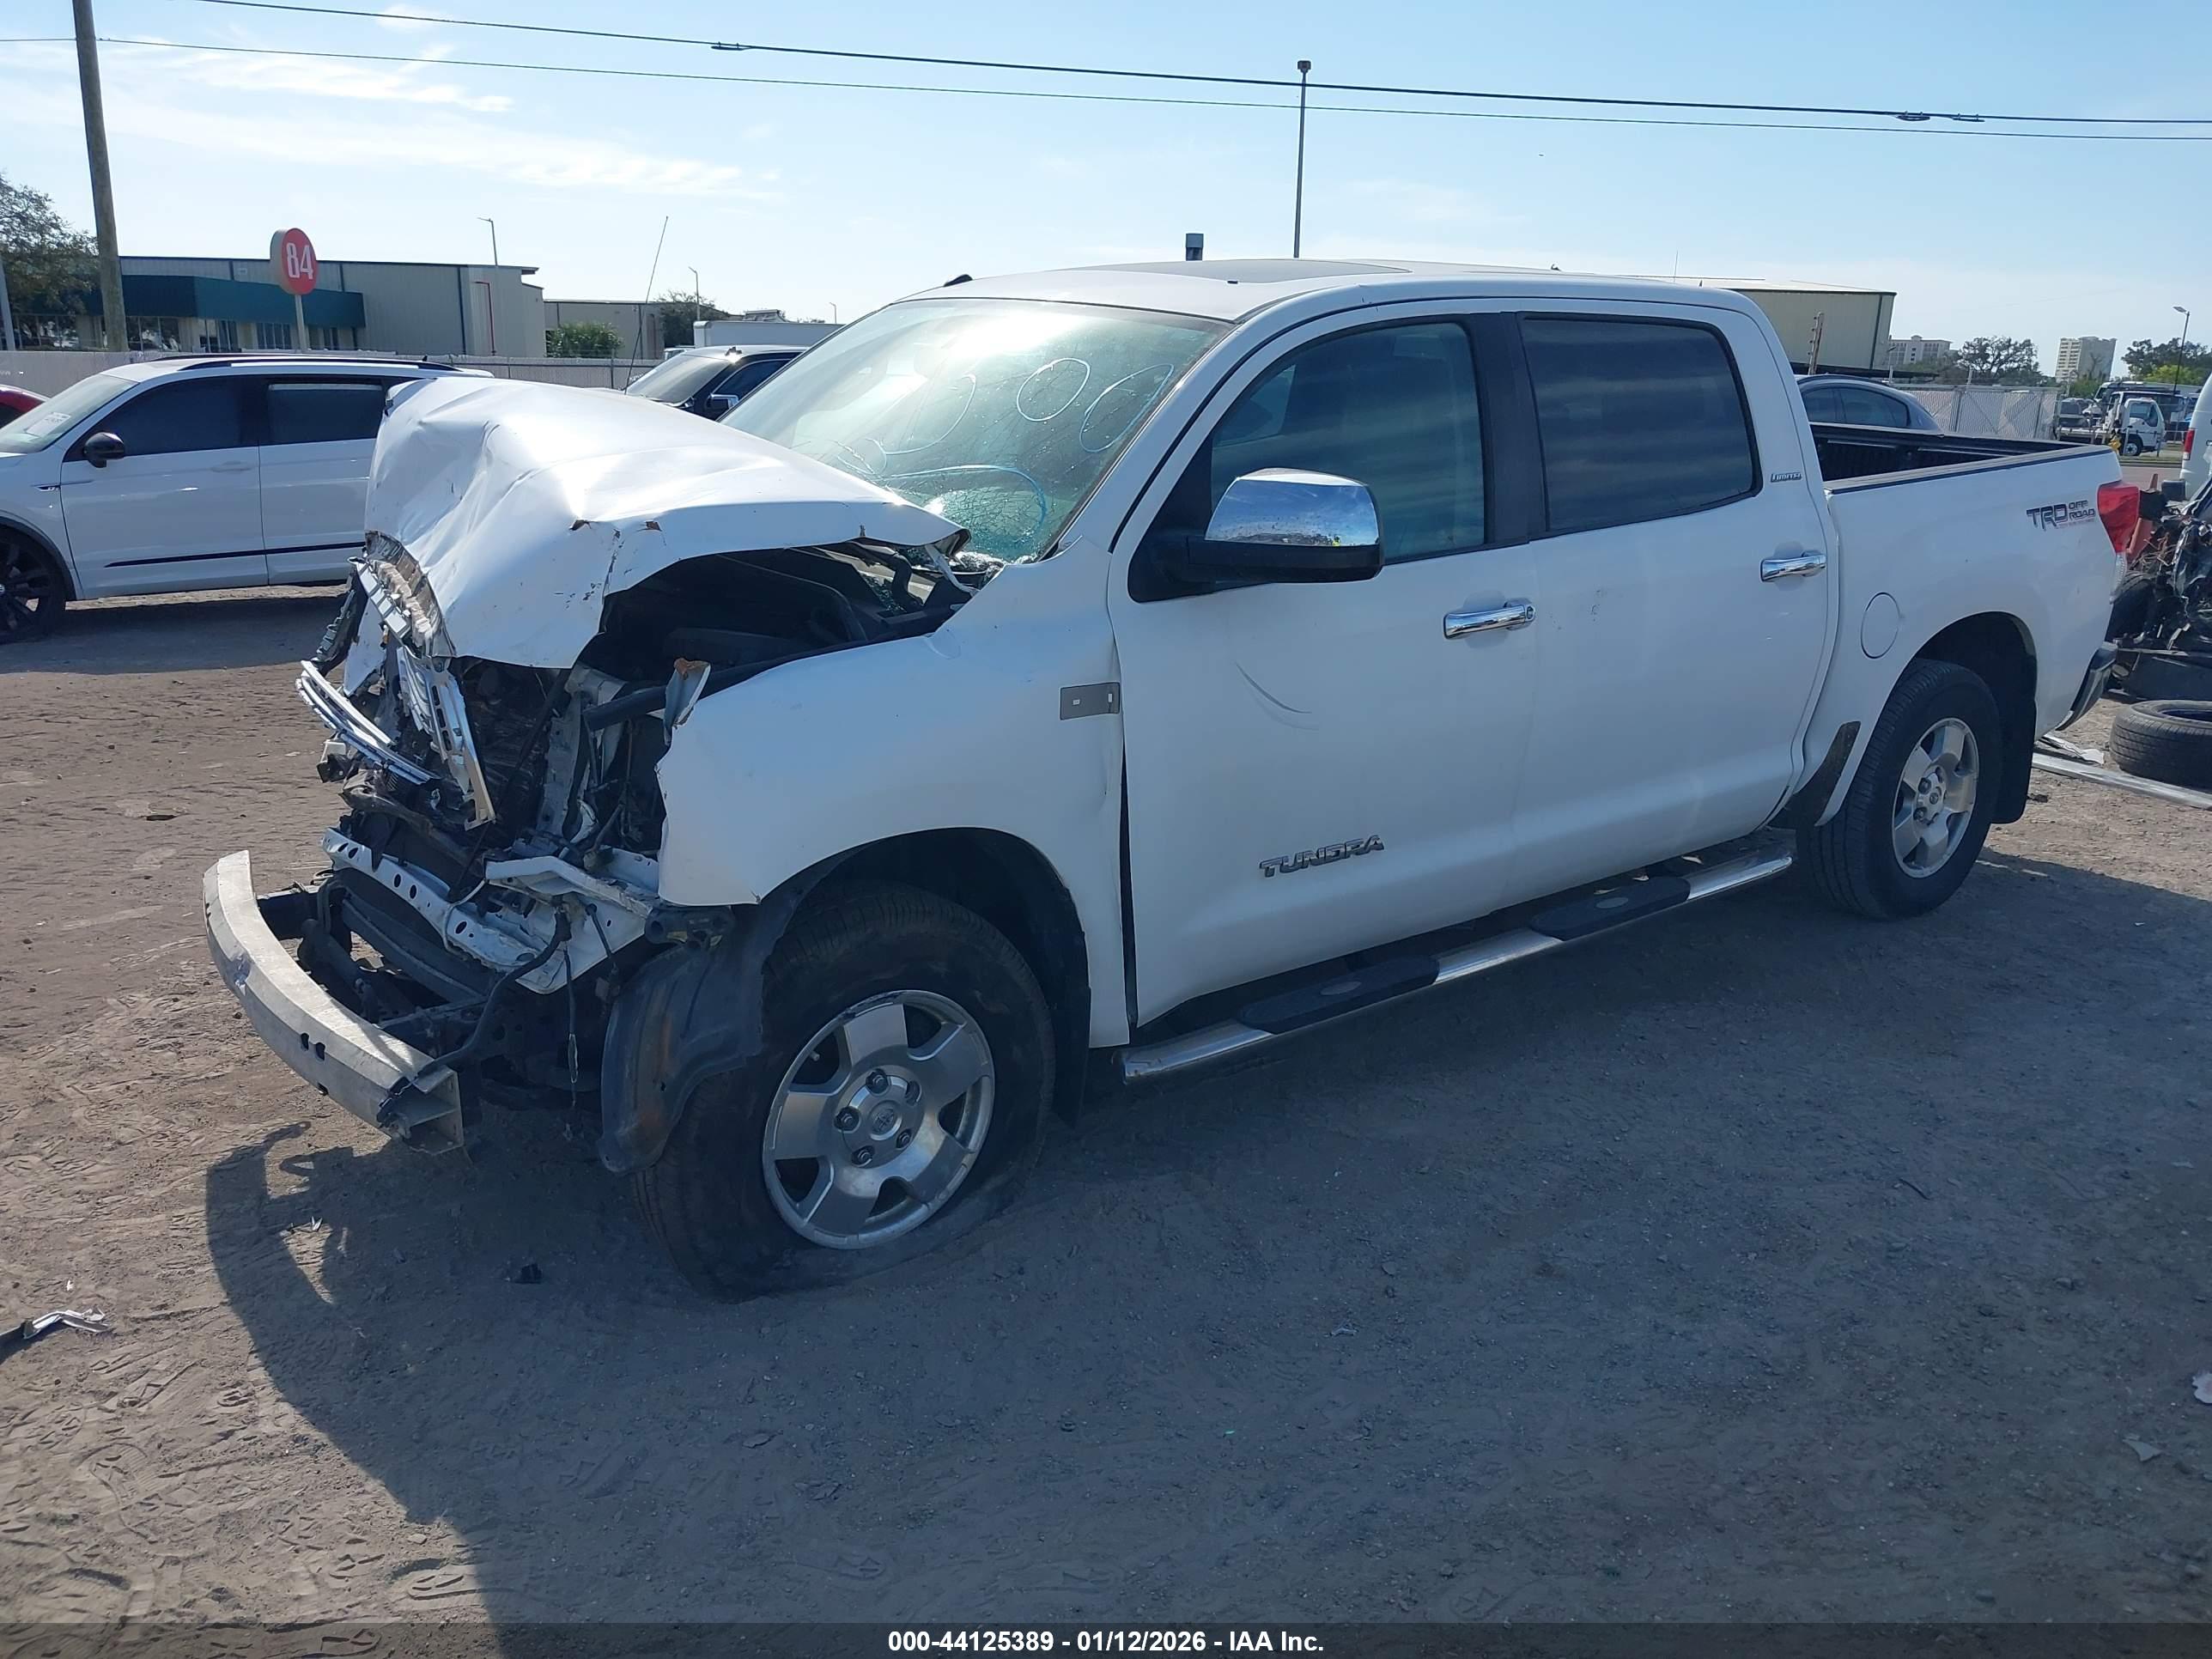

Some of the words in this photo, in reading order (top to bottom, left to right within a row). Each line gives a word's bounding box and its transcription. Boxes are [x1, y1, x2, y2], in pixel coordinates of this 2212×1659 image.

[286, 241, 314, 280] 84
[2026, 503, 2069, 531] TRD
[2068, 500, 2089, 510] OFF
[2069, 507, 2096, 521] ROAD
[1259, 834, 1385, 878] TUNDRA
